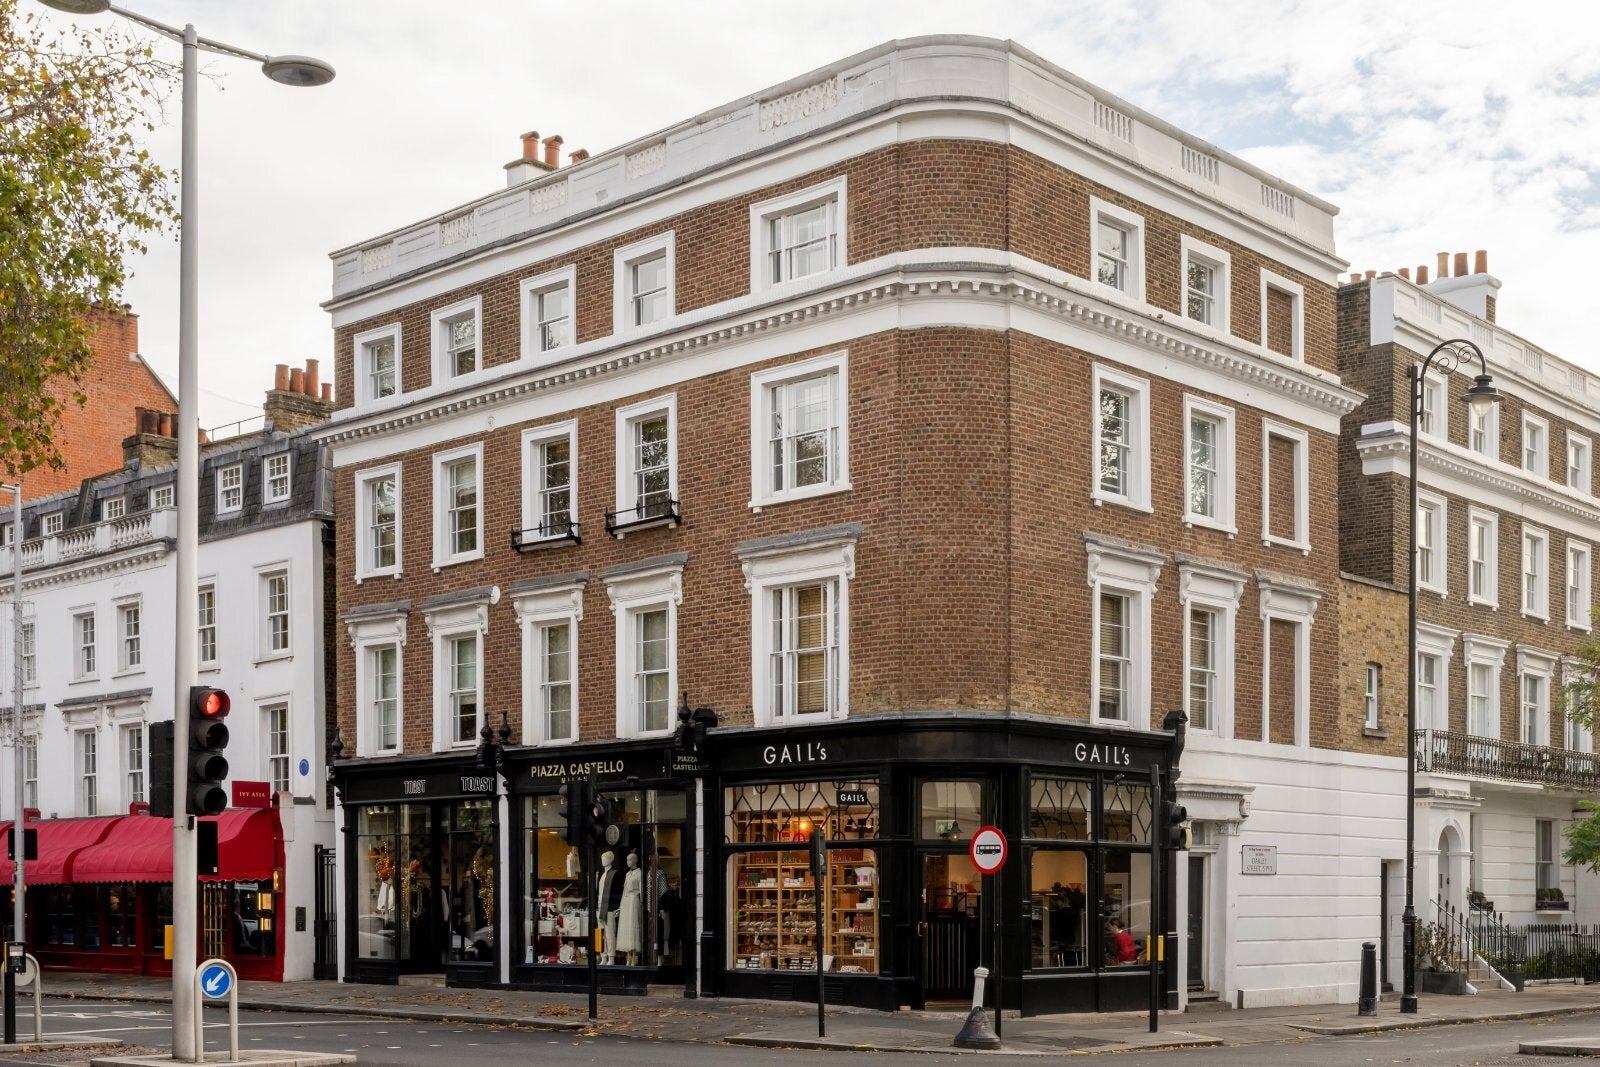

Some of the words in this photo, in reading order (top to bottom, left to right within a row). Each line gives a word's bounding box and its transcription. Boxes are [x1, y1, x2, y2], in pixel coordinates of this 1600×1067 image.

[677, 755, 698, 763] PIAZZA
[763, 742, 827, 765] GAIL's
[1074, 742, 1130, 766] GAIL's
[531, 764, 566, 778] PIAZZA
[672, 763, 700, 771] CASTELL
[403, 779, 426, 795] TOAST
[460, 776, 495, 792] TOAST
[840, 793, 865, 802] GAIL's
